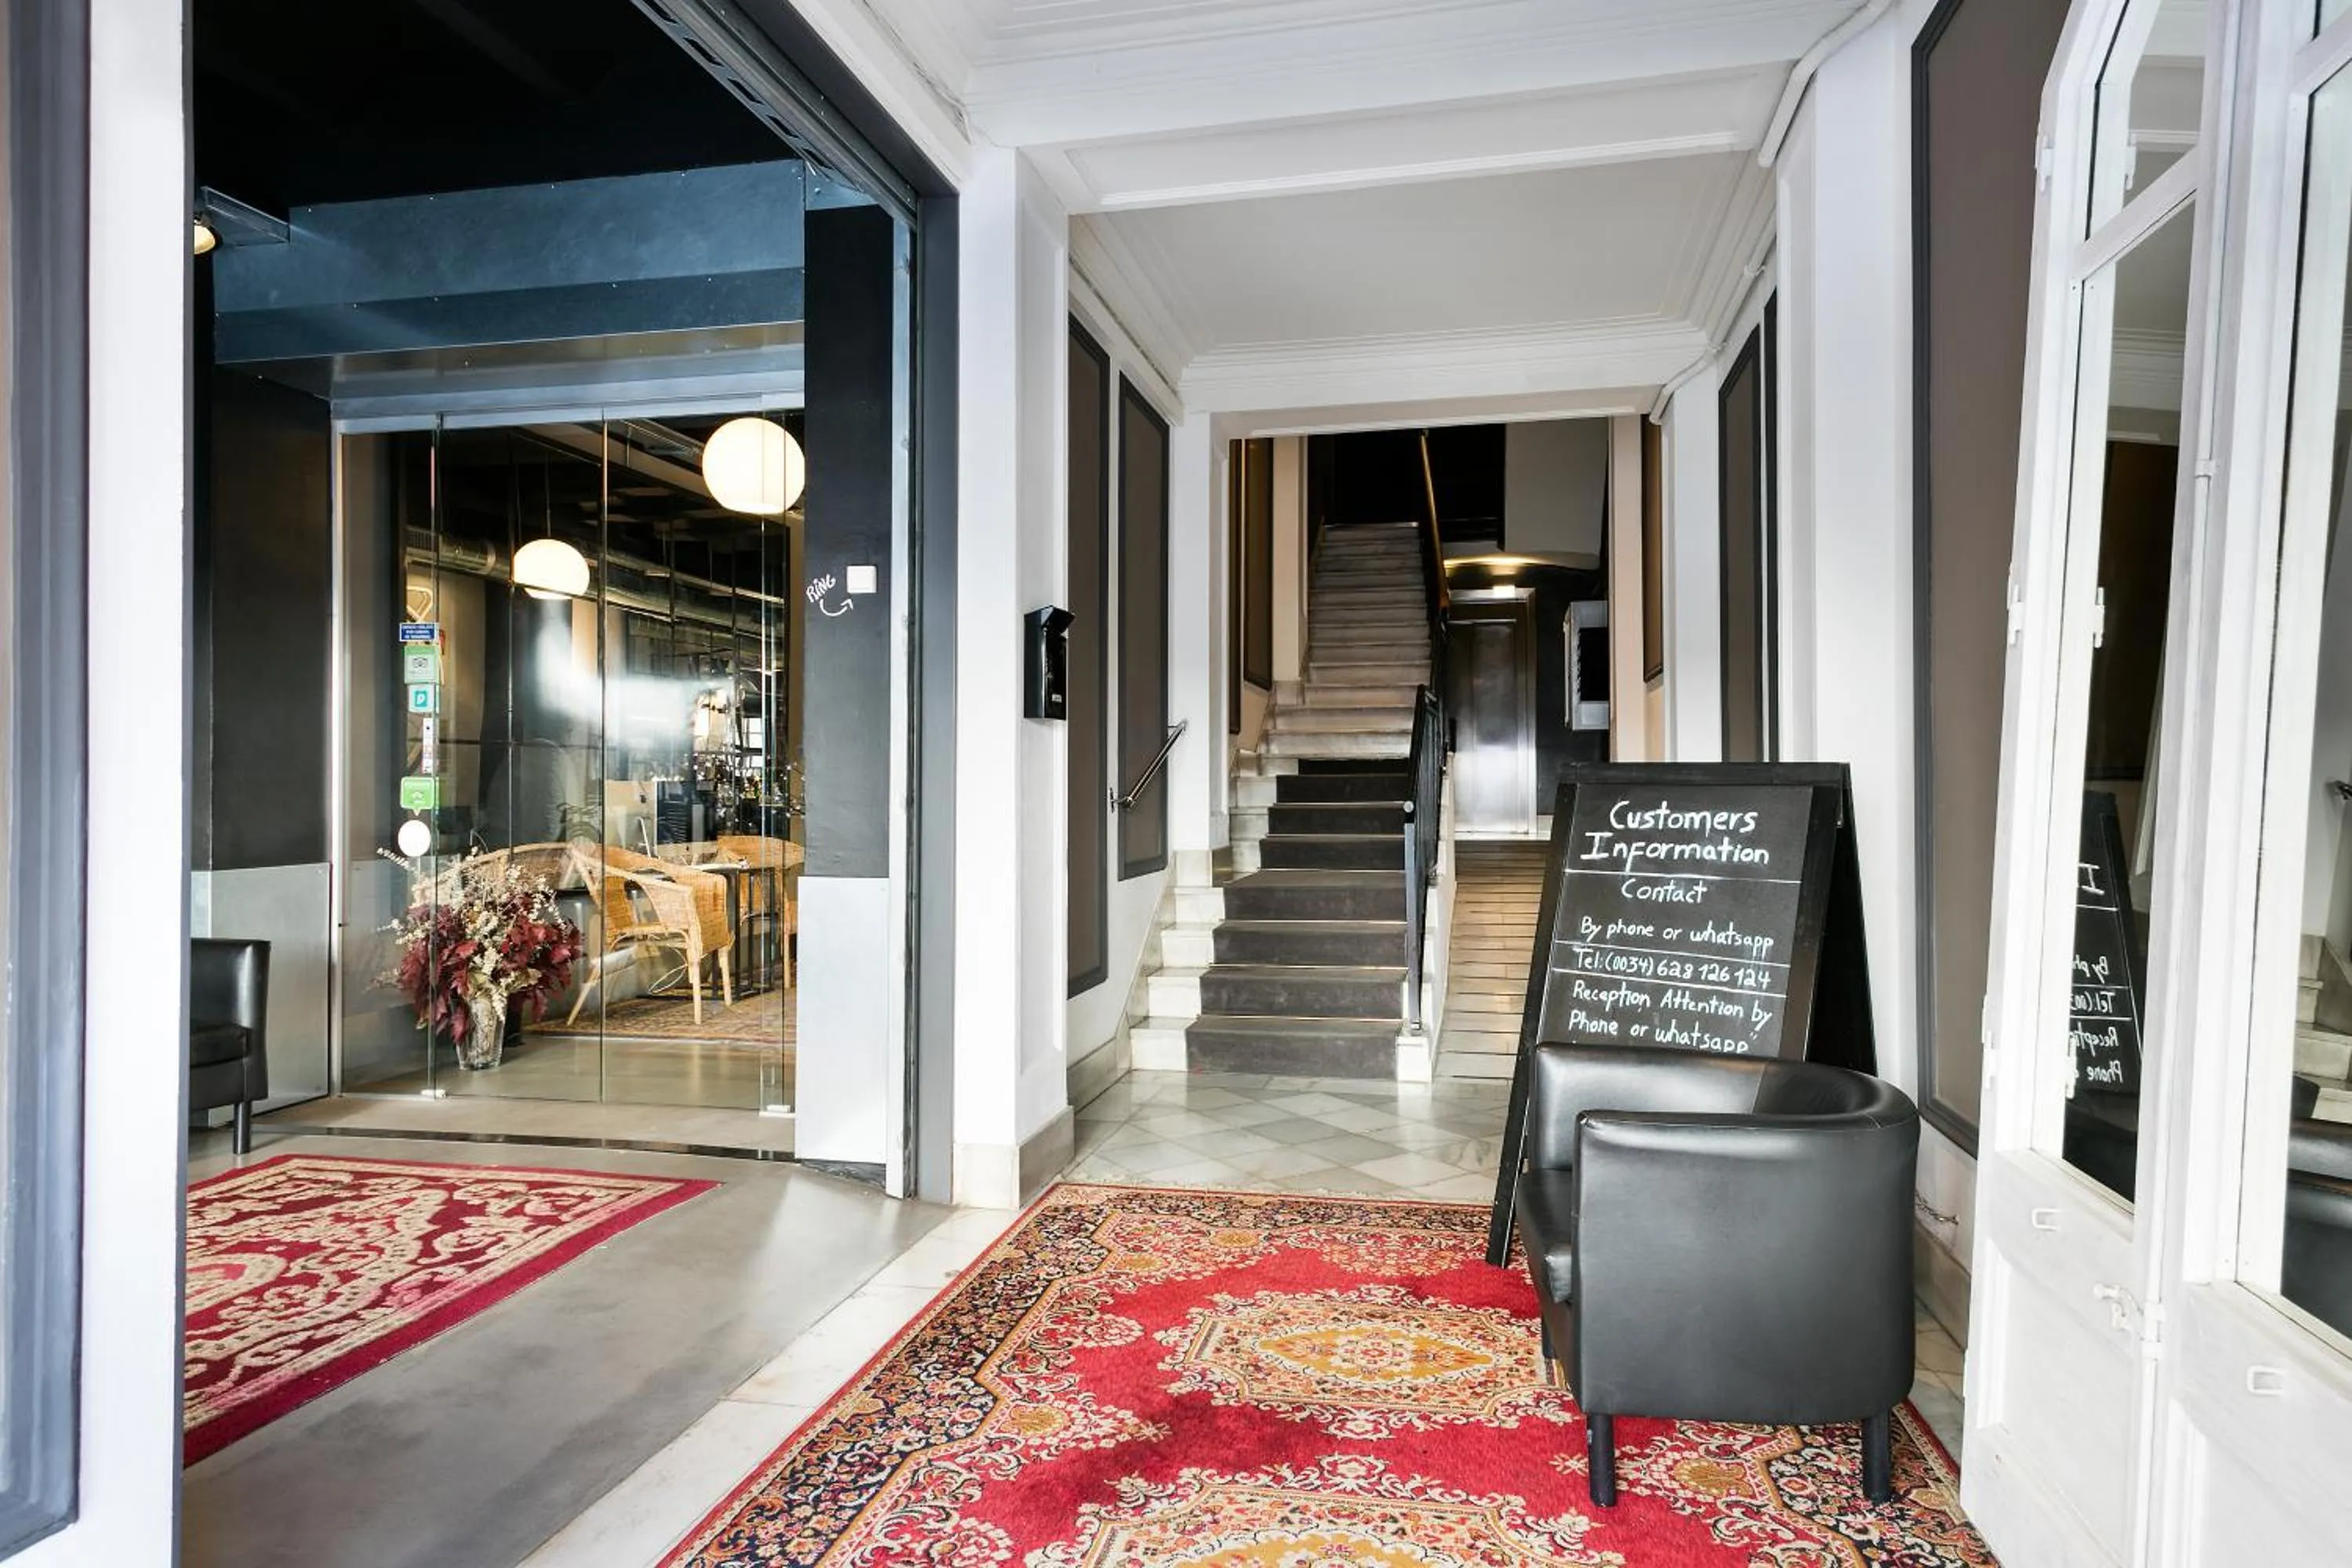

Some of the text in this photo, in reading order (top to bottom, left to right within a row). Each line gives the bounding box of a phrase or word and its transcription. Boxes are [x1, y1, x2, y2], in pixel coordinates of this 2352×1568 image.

[1610, 800, 1759, 837] Customers
[1621, 878, 1708, 904] Contact
[1581, 916, 1775, 958] By phone or whatsapp
[1657, 960, 1693, 979] 628
[1698, 964, 1730, 981] 126
[1734, 968, 1772, 989] 124
[1573, 979, 1773, 1032] Reception Attention by
[1569, 1010, 1618, 1036] Phone
[1630, 1024, 1650, 1037] or
